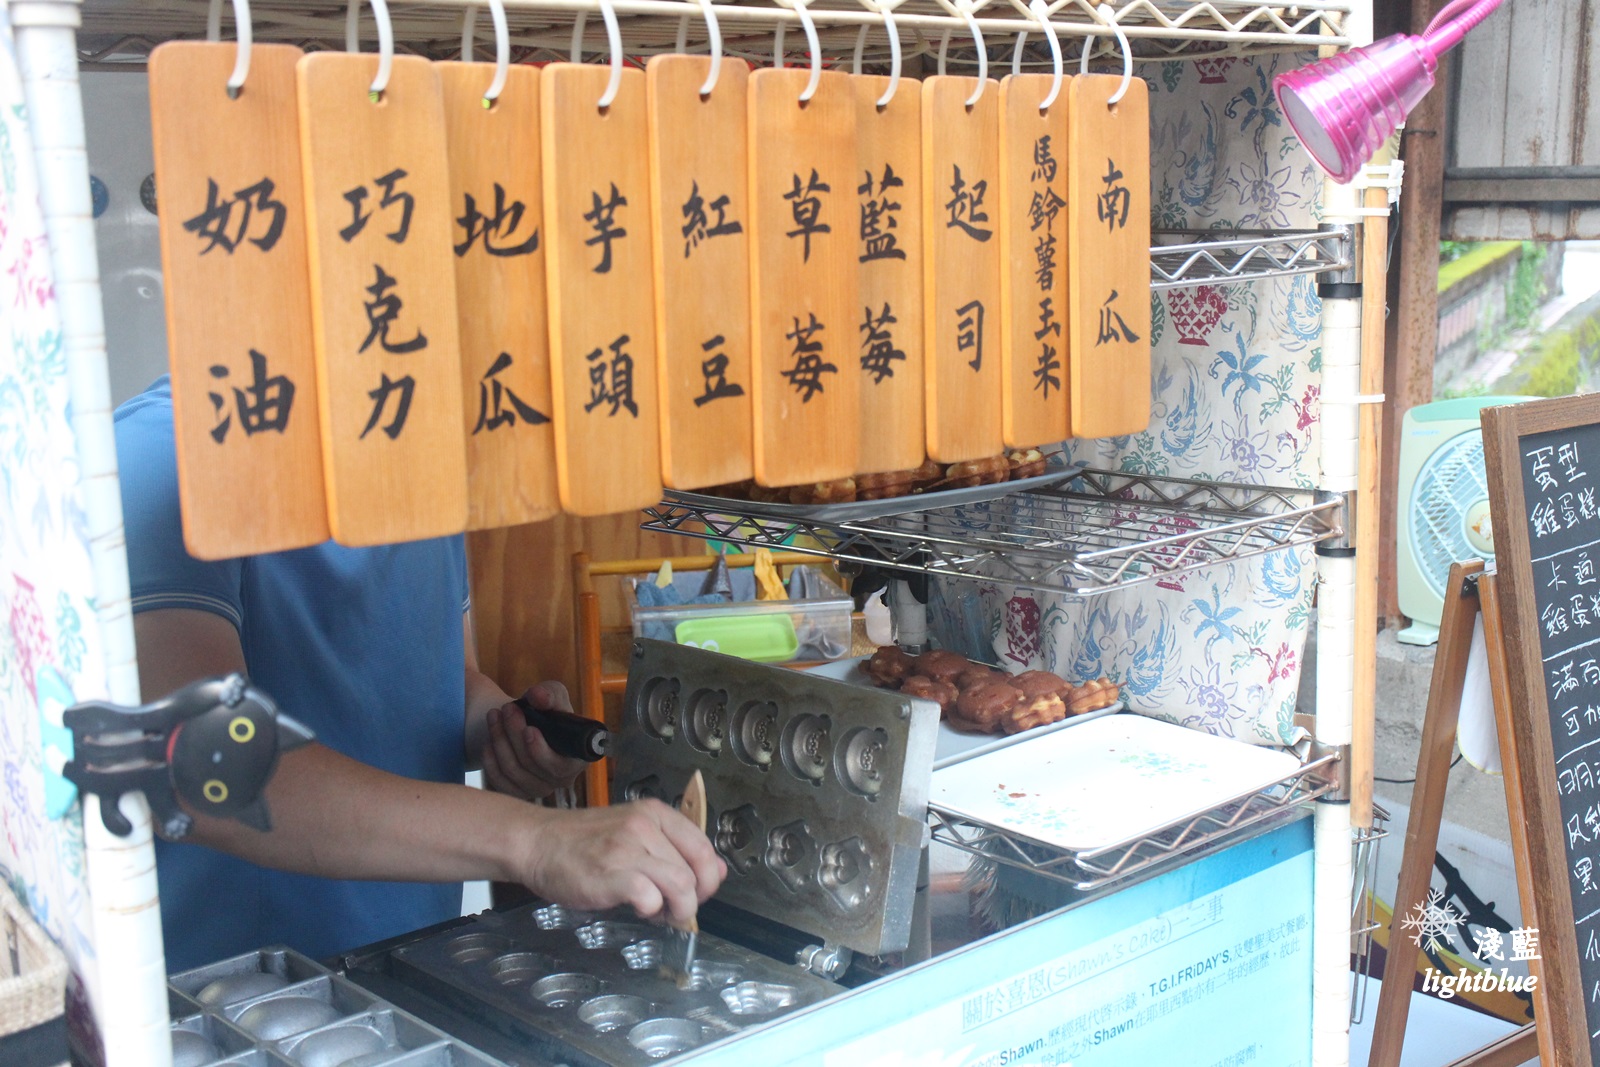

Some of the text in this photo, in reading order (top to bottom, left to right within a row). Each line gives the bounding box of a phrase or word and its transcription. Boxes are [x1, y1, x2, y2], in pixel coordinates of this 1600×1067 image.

[184, 178, 296, 443] 奶油
[340, 169, 427, 439] 巧克力
[453, 183, 551, 435] 地瓜
[584, 182, 639, 418] 芋頭
[682, 181, 744, 407] 紅豆
[781, 168, 838, 403] 草莓
[857, 163, 906, 384] 藍莓
[945, 164, 993, 373] 起司
[1027, 135, 1066, 400] 馬鈴薯玉米
[1095, 158, 1140, 348] 南瓜
